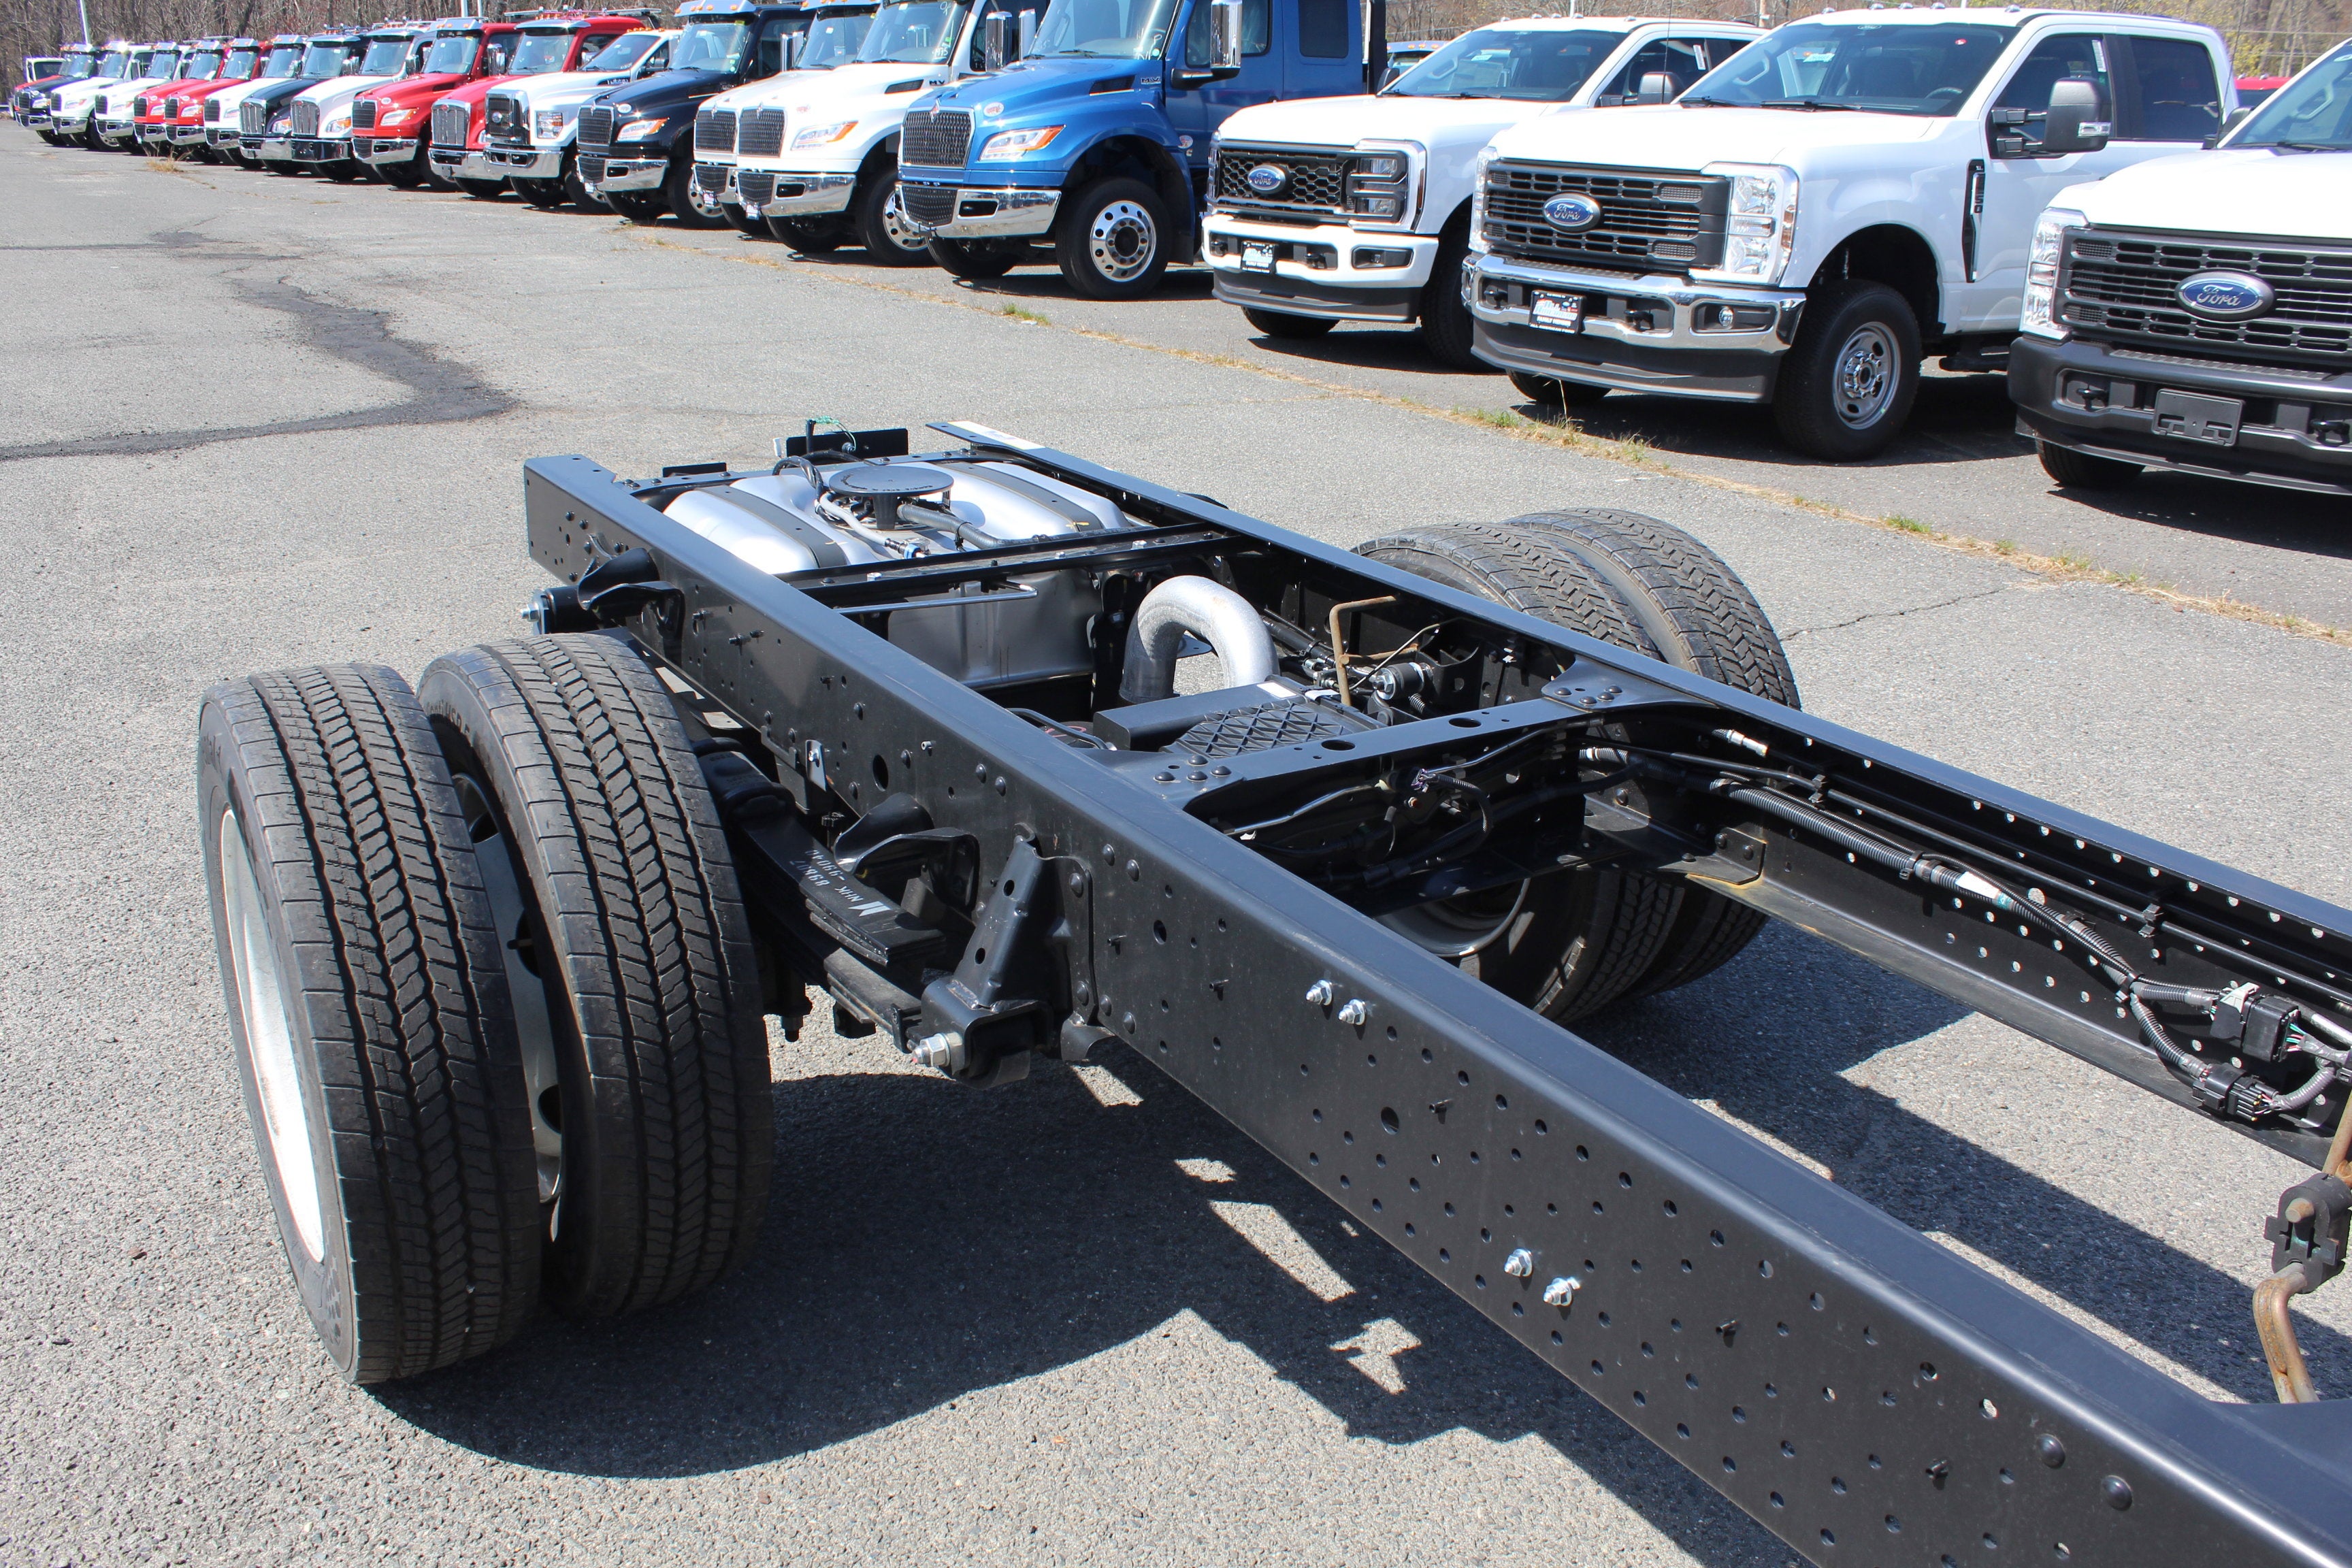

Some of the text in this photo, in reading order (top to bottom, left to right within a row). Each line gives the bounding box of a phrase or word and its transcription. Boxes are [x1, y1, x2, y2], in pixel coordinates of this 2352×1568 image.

[1254, 172, 1273, 186] Ford
[1554, 203, 1582, 220] Ford
[2197, 284, 2244, 306] Ford
[834, 885, 864, 902] NHK
